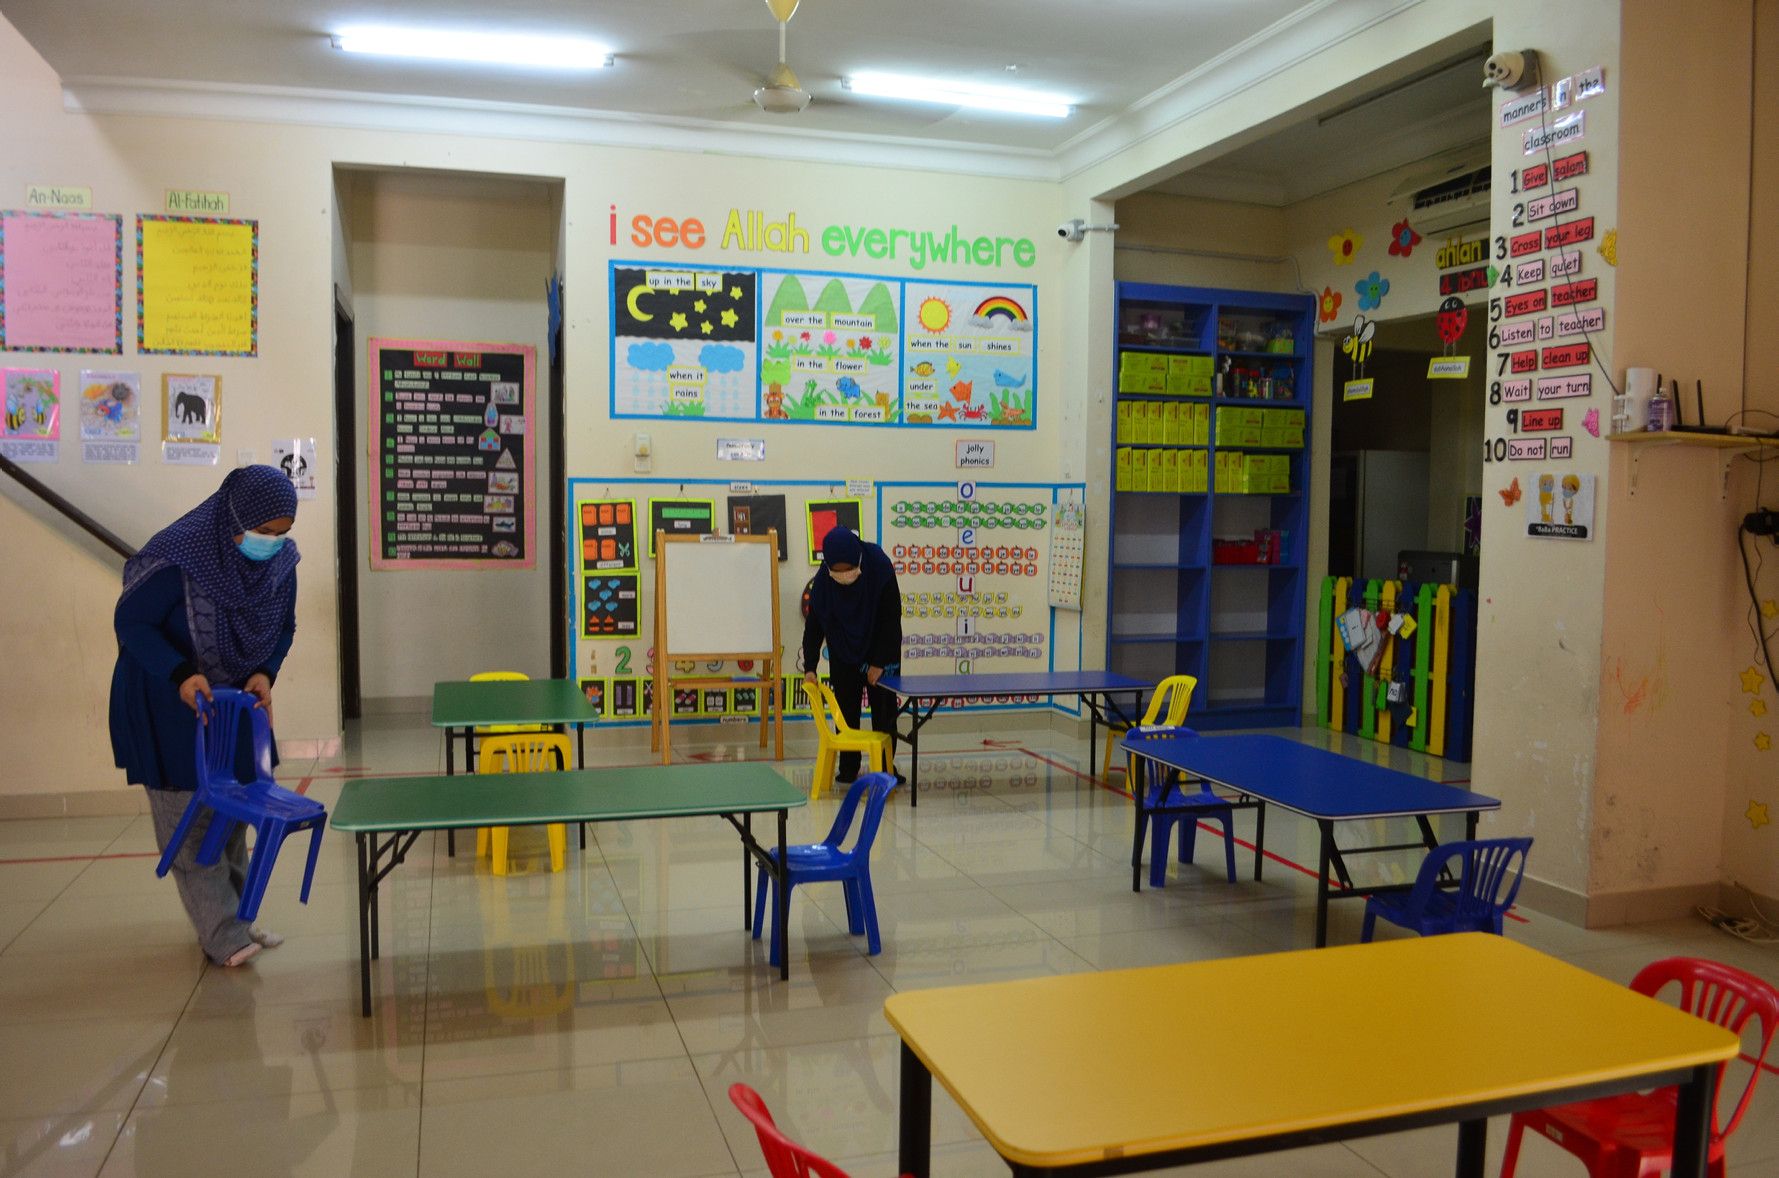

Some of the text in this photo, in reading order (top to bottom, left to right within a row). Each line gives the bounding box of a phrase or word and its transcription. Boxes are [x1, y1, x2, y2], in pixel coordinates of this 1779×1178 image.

[1503, 97, 1546, 122] manners
[1524, 123, 1579, 151] classroom
[1510, 160, 1585, 194] 1 Give salam
[1512, 196, 1575, 228] 2 Sit down
[609, 204, 1036, 270] i see Allah everywhere
[1495, 222, 1591, 260] 3 Cross your leg
[1436, 236, 1482, 269] ahlan
[649, 277, 717, 288] up in the sky
[1500, 264, 1513, 288] 4
[1517, 266, 1542, 281] Keep
[1551, 257, 1578, 276] quiet
[1490, 286, 1595, 323] 5 Eyes on teacher
[785, 316, 873, 328] over the mountain
[1488, 316, 1602, 349] 6 Listen to teacher
[911, 339, 932, 348] when
[936, 340, 949, 348] the
[987, 342, 1012, 350] shines
[416, 351, 479, 367] Word Wall
[797, 359, 863, 370] in the flower
[1497, 350, 1588, 377] 7 Help clean up
[670, 371, 703, 380] when it
[909, 381, 934, 391] under
[675, 389, 698, 397] rains
[1489, 381, 1589, 406] 8 Wait your turn
[819, 408, 881, 418] in the forest
[906, 402, 920, 410] the
[1506, 408, 1561, 434] 9 Line up
[960, 456, 990, 467] phonics
[1484, 437, 1569, 463] 10 Do not run
[962, 529, 974, 544] e
[959, 577, 973, 593] u
[964, 619, 968, 635] i
[615, 646, 632, 675] 2
